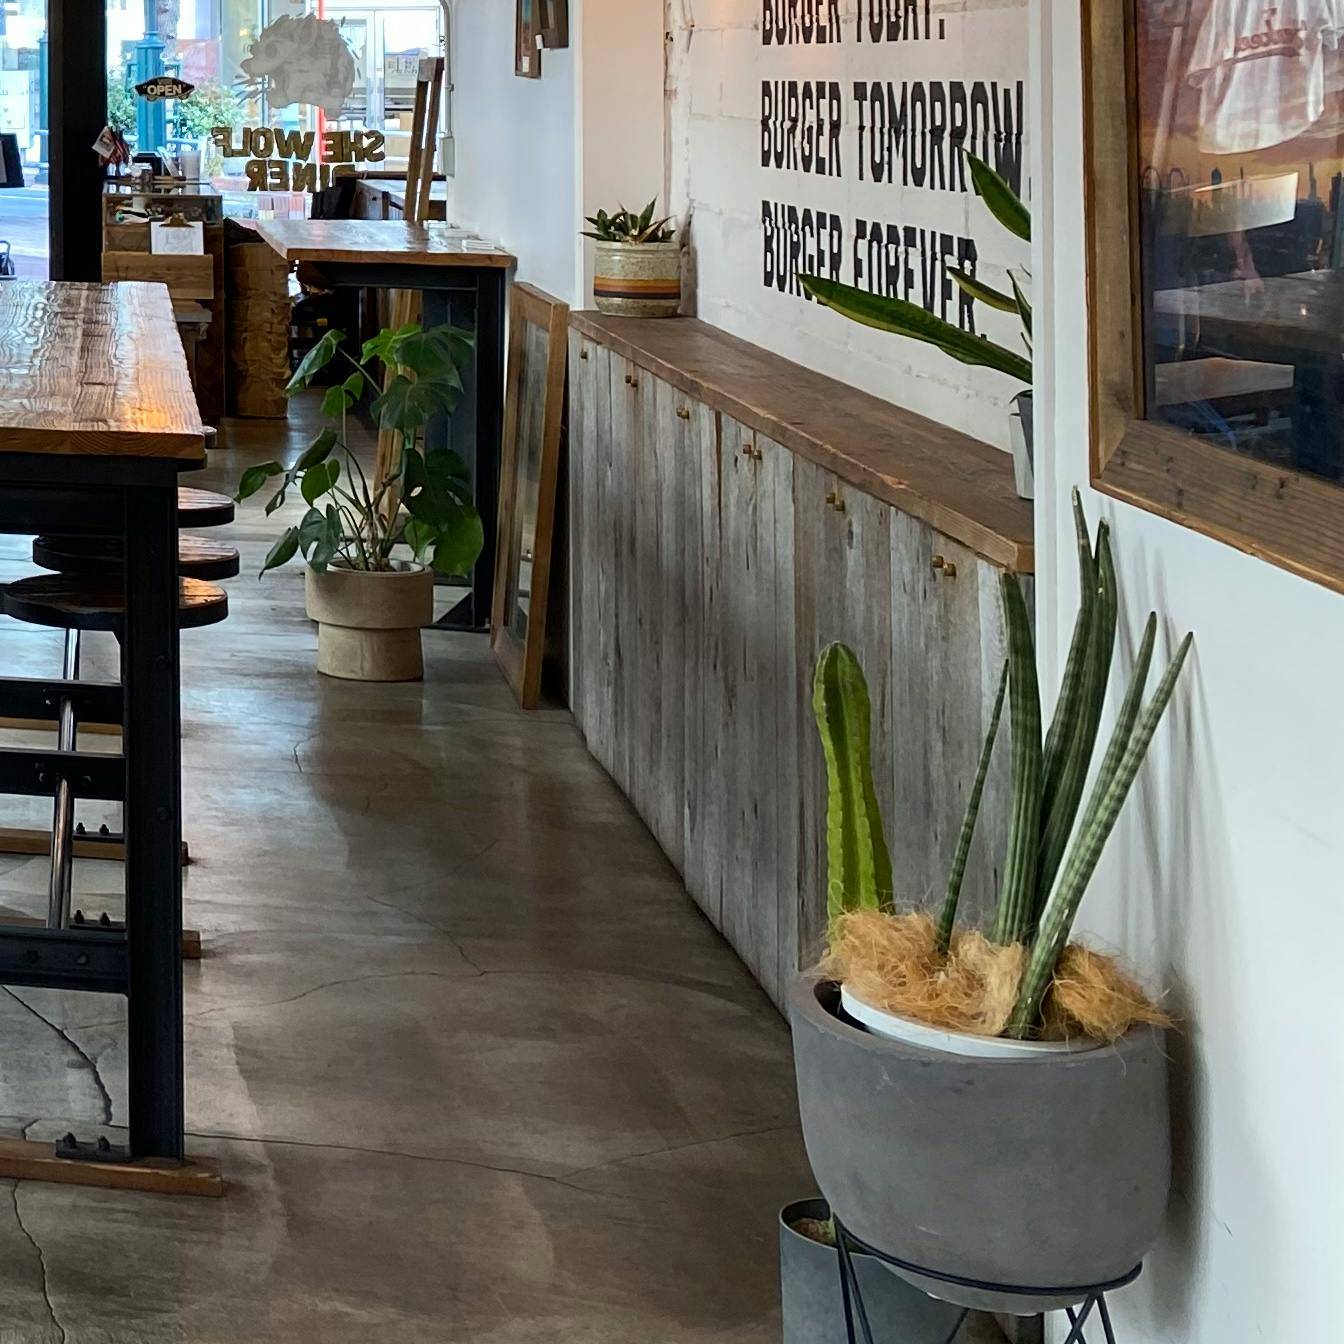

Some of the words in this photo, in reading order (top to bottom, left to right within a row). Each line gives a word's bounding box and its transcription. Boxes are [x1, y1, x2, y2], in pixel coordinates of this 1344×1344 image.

[146, 84, 182, 96] OPEN
[761, 80, 842, 177] BURGER
[761, 199, 843, 305] BURGER
